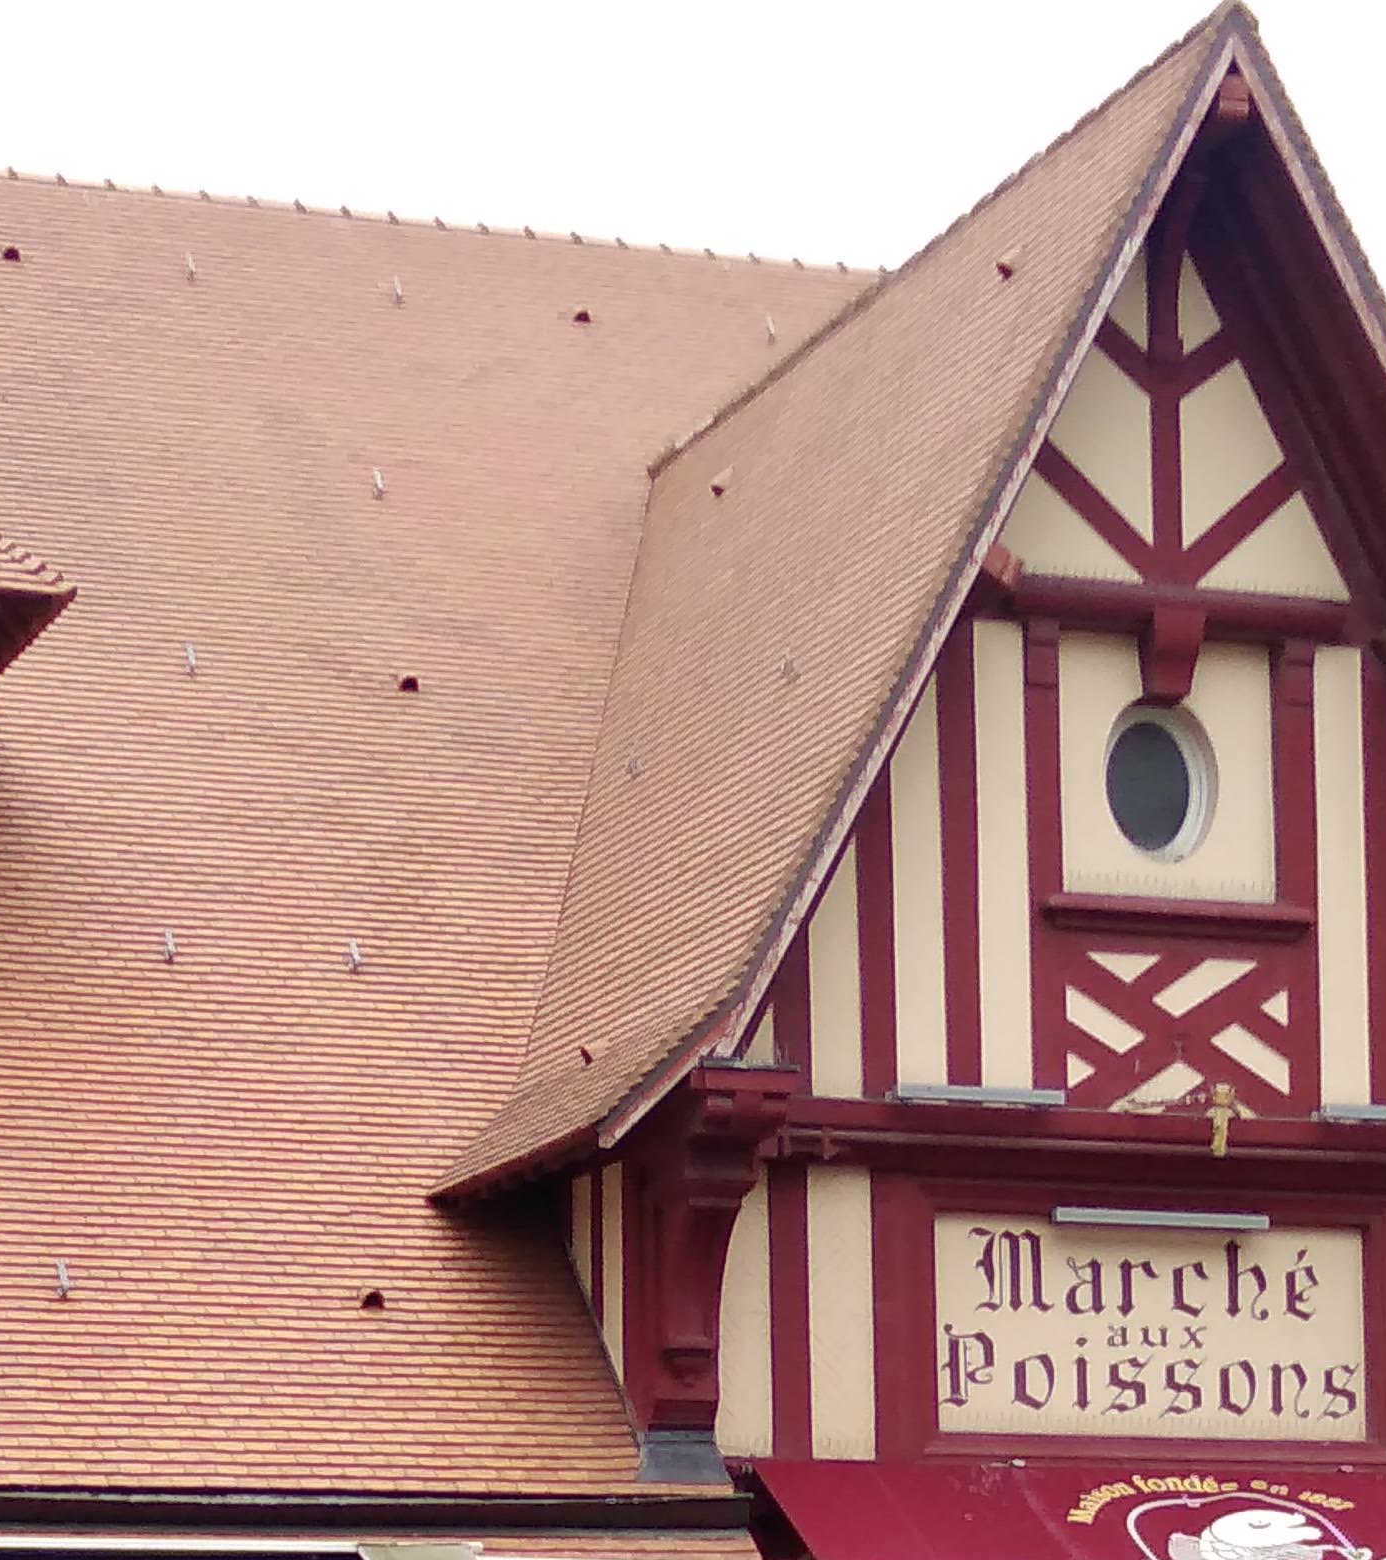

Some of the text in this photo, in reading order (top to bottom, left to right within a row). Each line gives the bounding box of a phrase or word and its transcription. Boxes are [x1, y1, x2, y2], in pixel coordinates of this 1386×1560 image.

[968, 1227, 1320, 1321] Marché
[939, 1323, 1360, 1420] Poissons
[1107, 1324, 1208, 1350] aux
[1067, 1481, 1137, 1525] Maison
